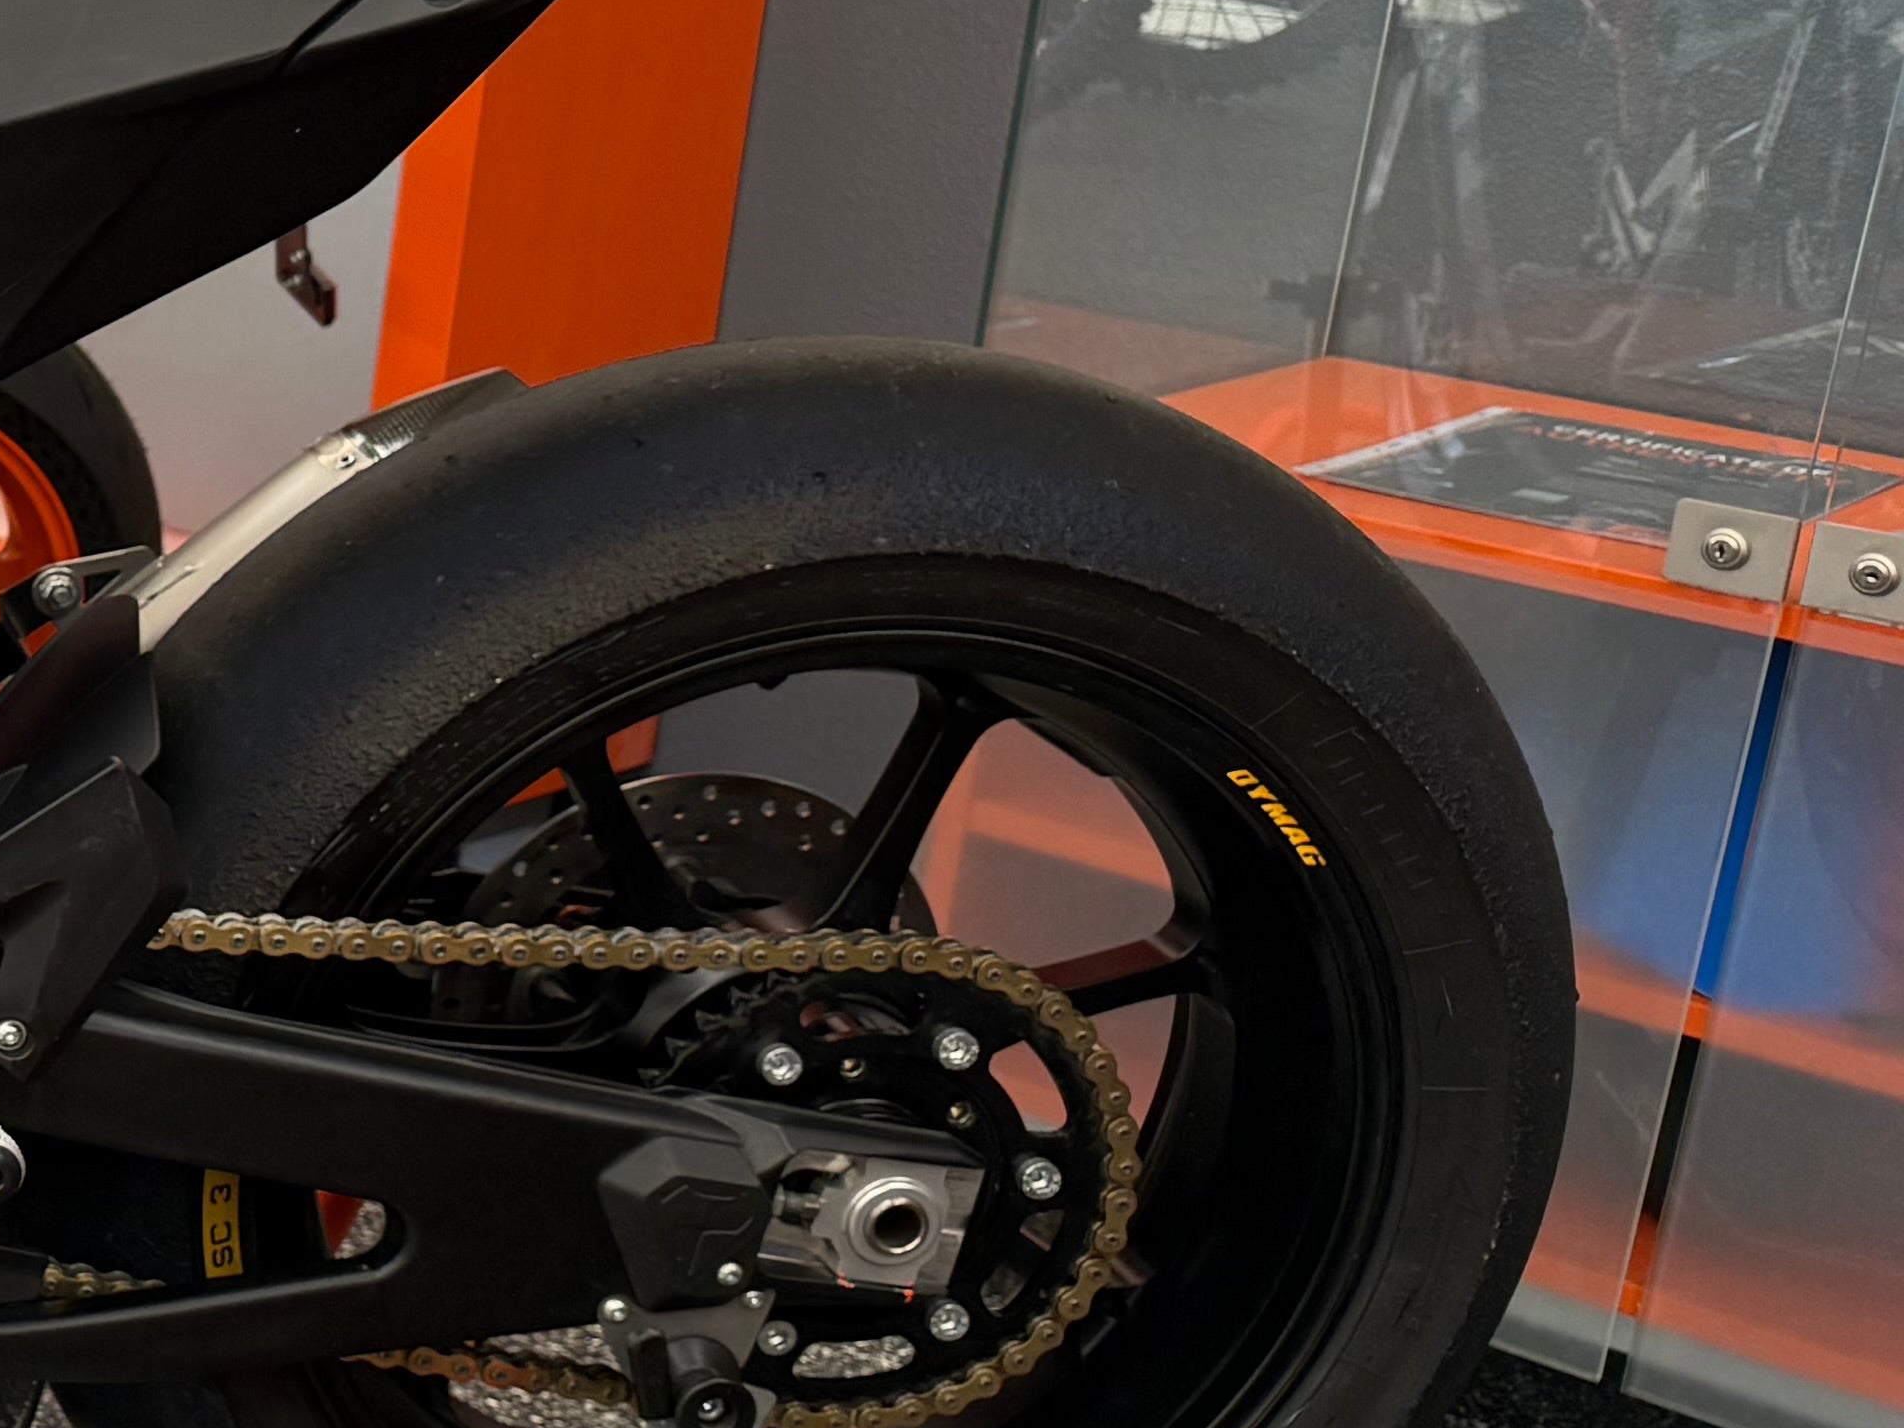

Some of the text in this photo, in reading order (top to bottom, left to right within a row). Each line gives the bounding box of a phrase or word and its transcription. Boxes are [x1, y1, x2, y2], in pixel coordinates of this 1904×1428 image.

[1226, 768, 1327, 868] DYMAG
[209, 1182, 234, 1270] SC 3
